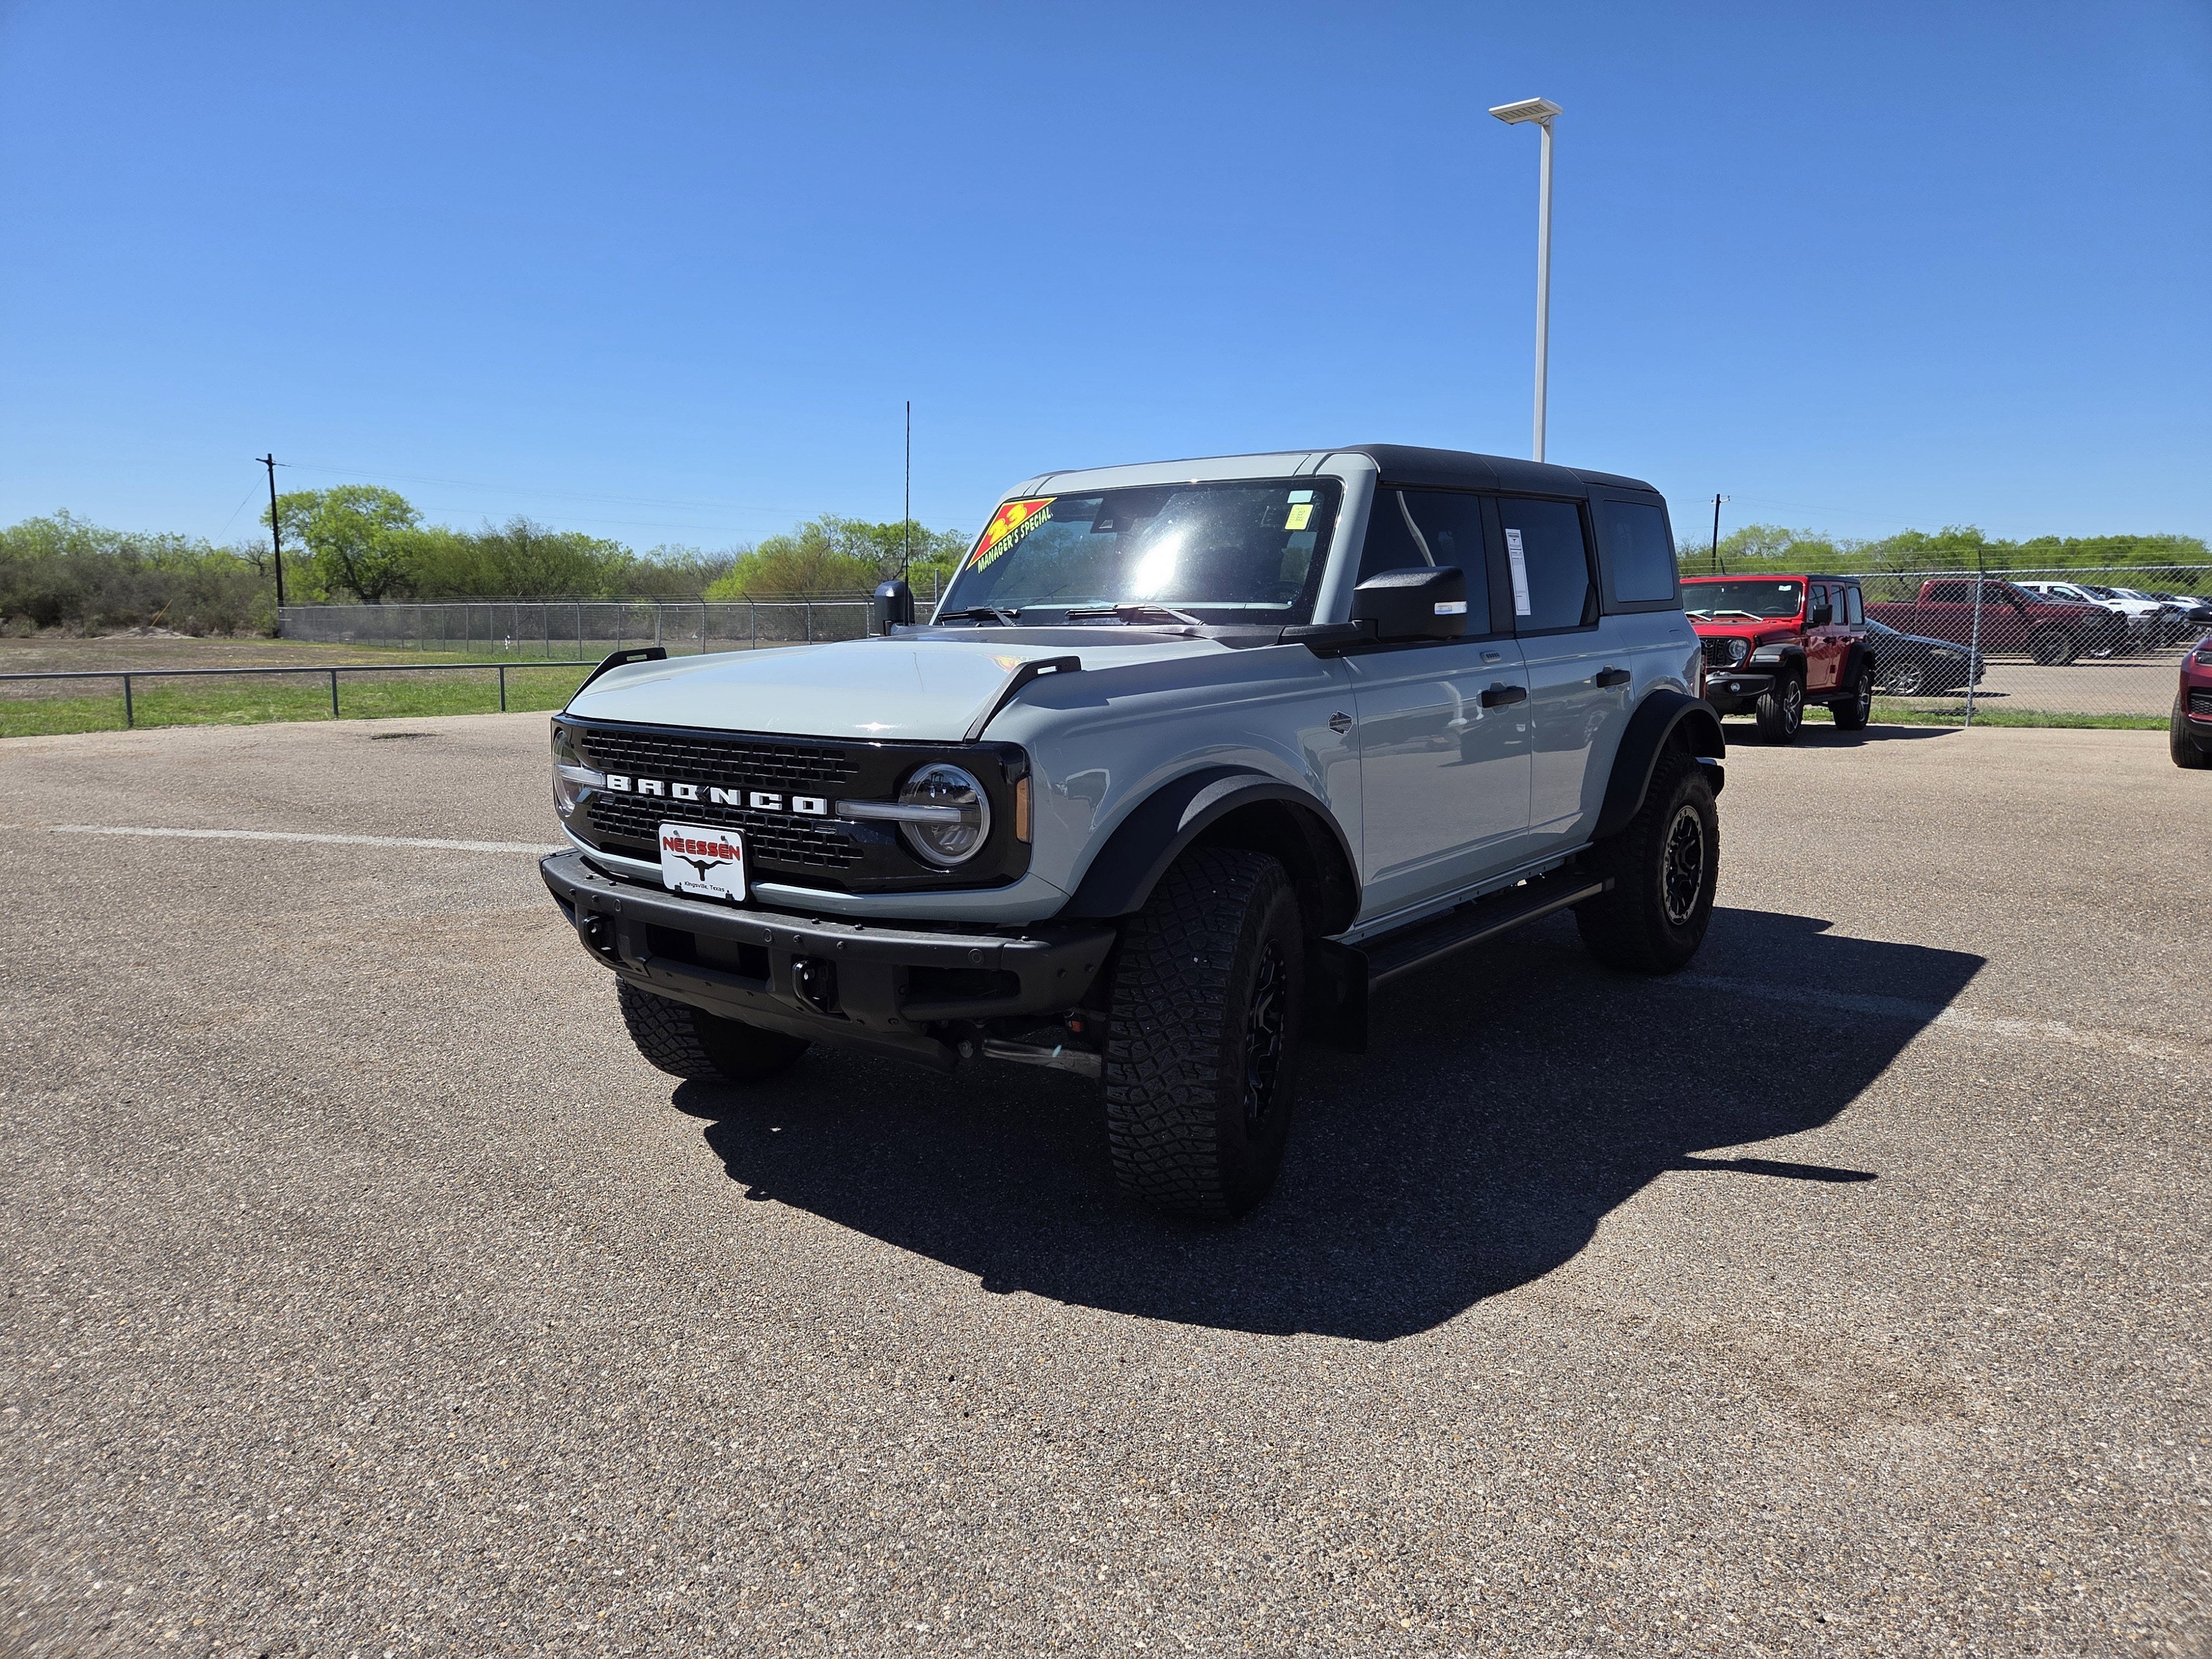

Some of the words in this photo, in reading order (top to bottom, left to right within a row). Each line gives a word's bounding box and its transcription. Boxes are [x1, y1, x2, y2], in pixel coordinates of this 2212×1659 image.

[978, 528, 1019, 573] MANAGER'S
[1020, 507, 1051, 539] SPECIAL
[988, 503, 1027, 545] 23
[607, 774, 827, 815] BRONCO
[662, 836, 740, 861] NEESSEN
